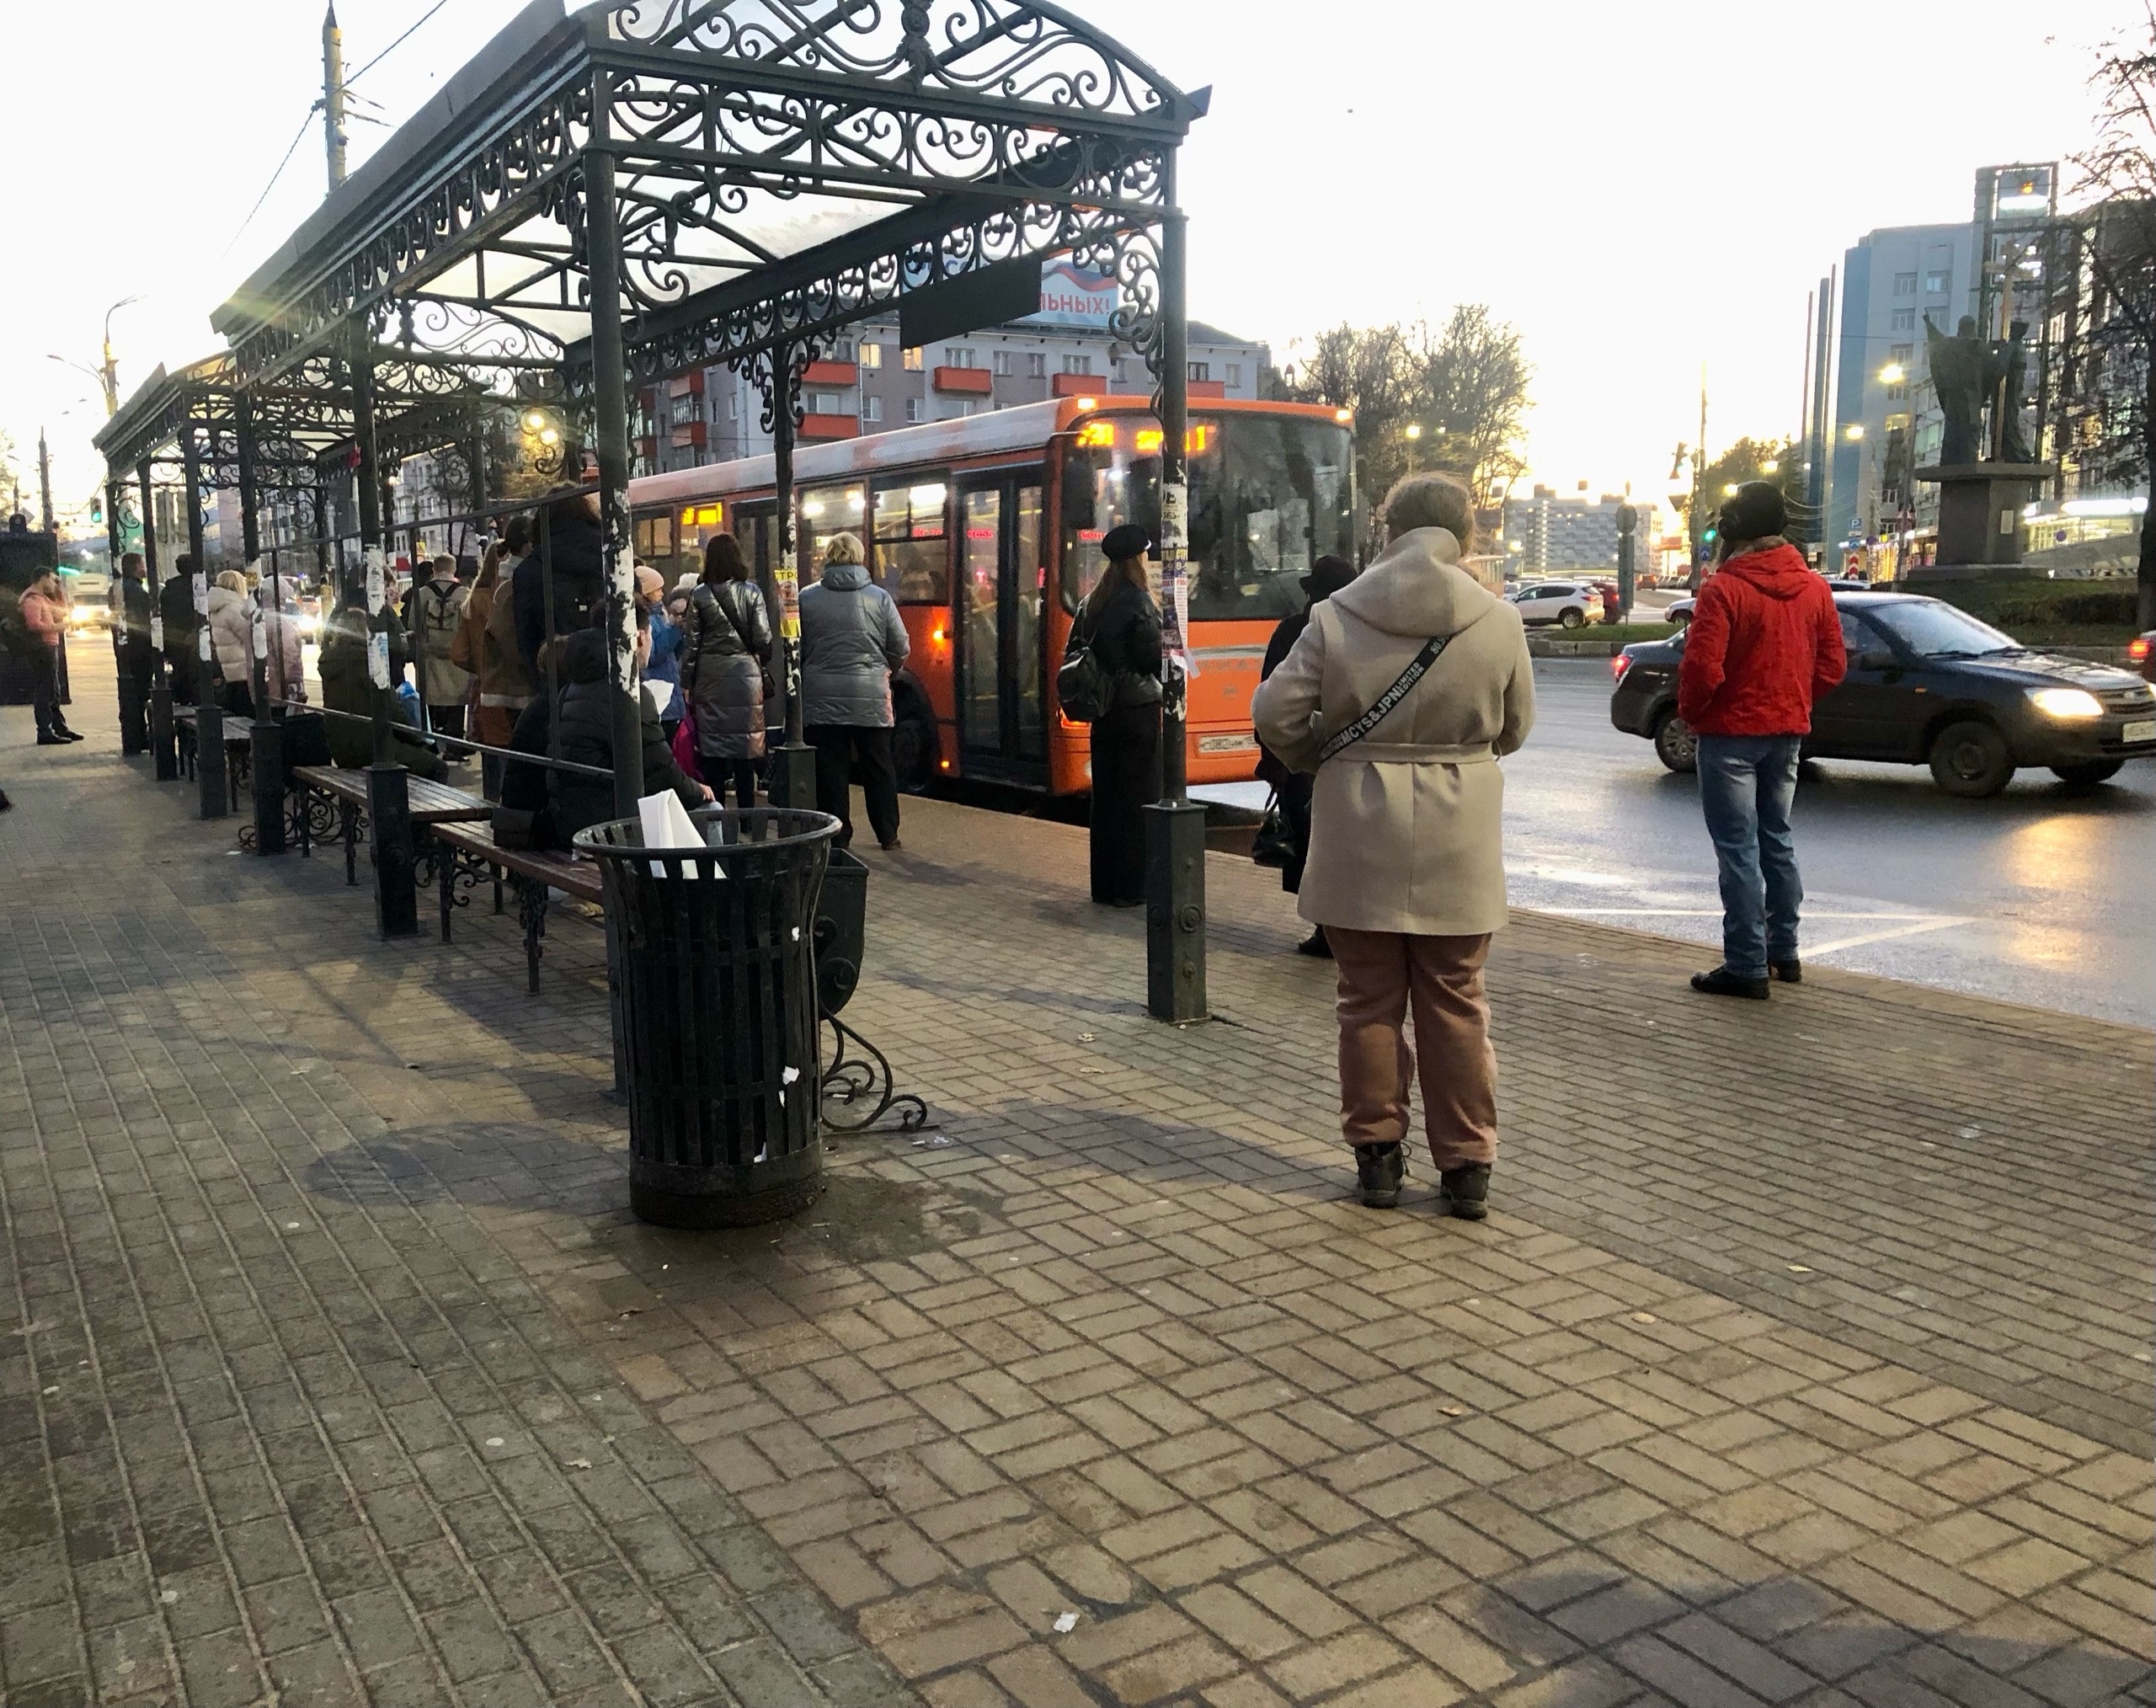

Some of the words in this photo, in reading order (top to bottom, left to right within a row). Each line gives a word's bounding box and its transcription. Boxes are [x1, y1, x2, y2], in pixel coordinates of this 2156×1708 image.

[1395, 662, 1420, 690] LIMITED
[1399, 666, 1425, 694] EDITION
[1342, 686, 1402, 745] MCYS&JPN
